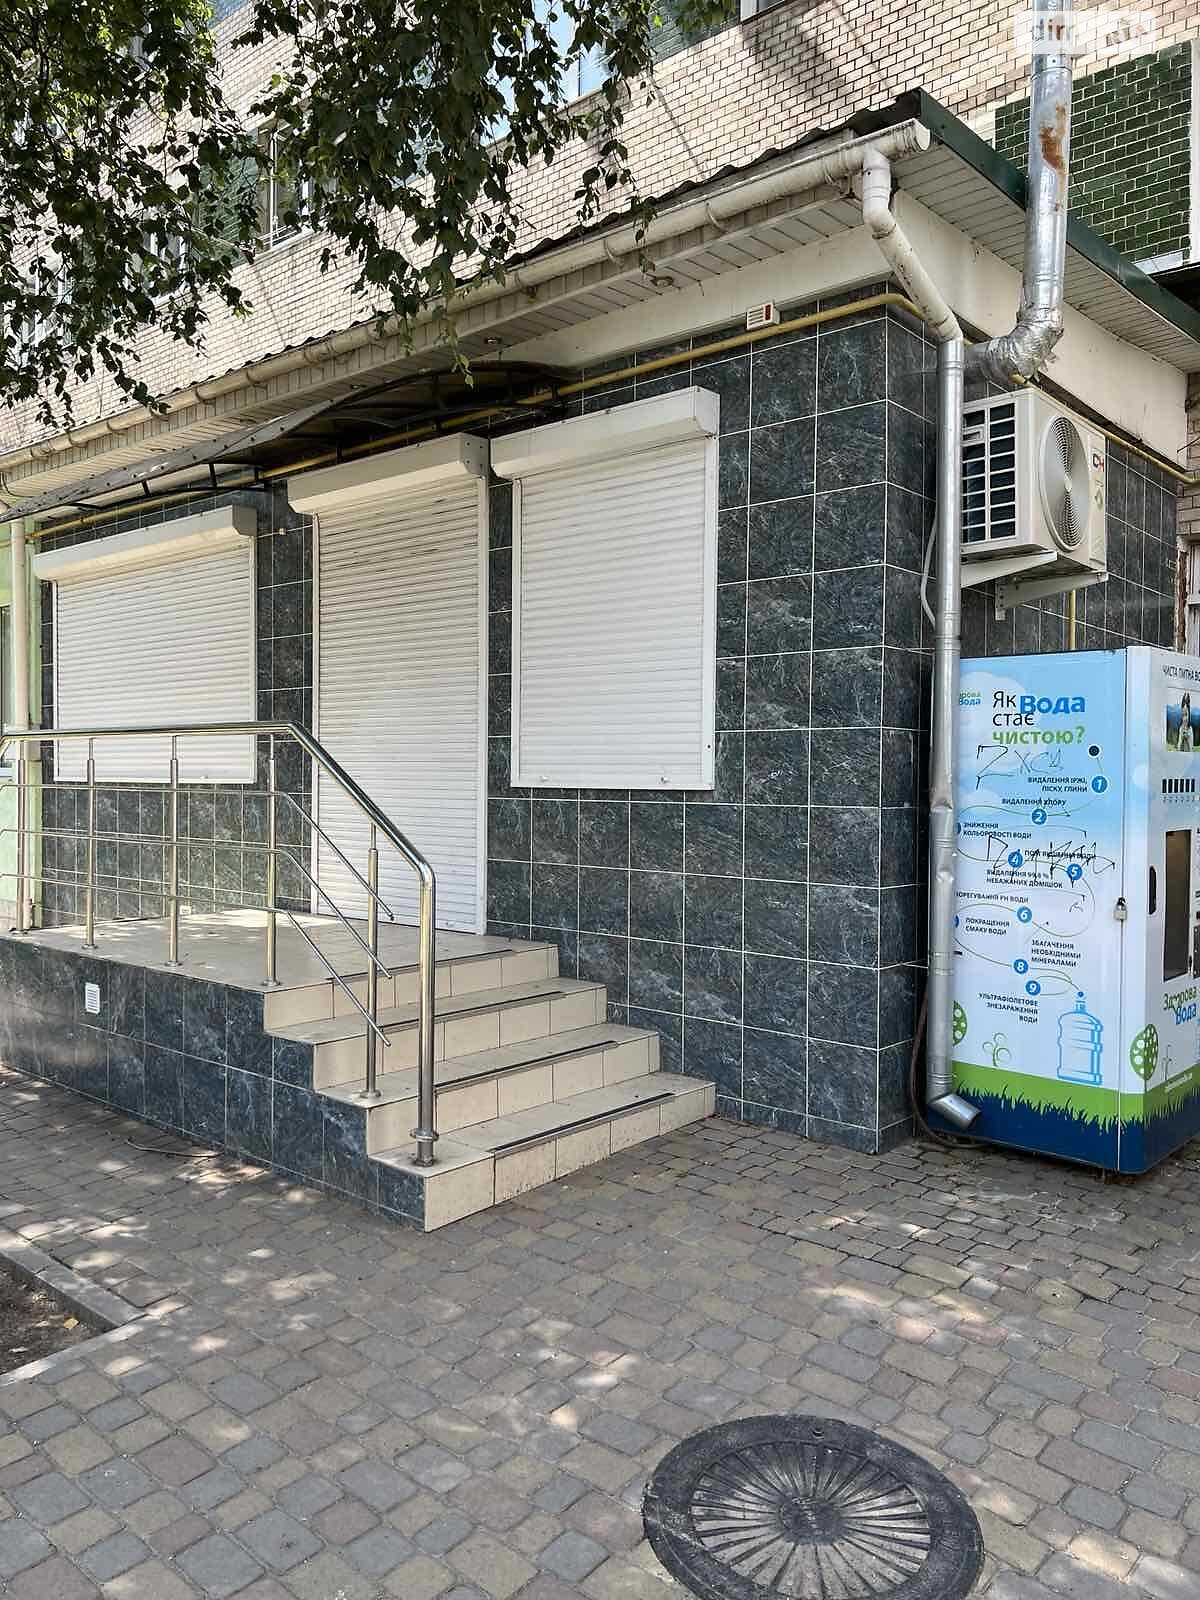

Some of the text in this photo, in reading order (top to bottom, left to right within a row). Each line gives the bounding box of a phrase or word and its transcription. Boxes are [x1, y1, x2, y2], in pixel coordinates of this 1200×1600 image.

[992, 690, 1085, 714] Як Вода
[992, 712, 1035, 726] стає
[992, 725, 1085, 744] чистою?
[1028, 777, 1069, 785] ВИДАЛЕННЯ
[1002, 798, 1042, 806] ВИДАЛЕННЯ
[963, 830, 1012, 838] КОЛЬОРОВОСТІ
[1028, 880, 1063, 889] ДОМІШОК
[965, 918, 1010, 927] ПОКРАЩЕННЯ
[965, 926, 988, 934] СМАКУ
[1031, 940, 1074, 950] ЗБАГАЧЕННЯ
[1031, 949, 1081, 959] НЕОБХІДНИМИ
[1031, 957, 1077, 967] МІНЕРАЛАМИ
[978, 993, 1038, 1007] УЛЬТРАФІОЛЕТОВЕ
[1163, 986, 1197, 1013] Здорова
[986, 1002, 1038, 1015] ЗНЕЗАРАЖЕННЯ
[1019, 1015, 1038, 1023] ВОДИ
[1175, 1003, 1197, 1026] Вода
